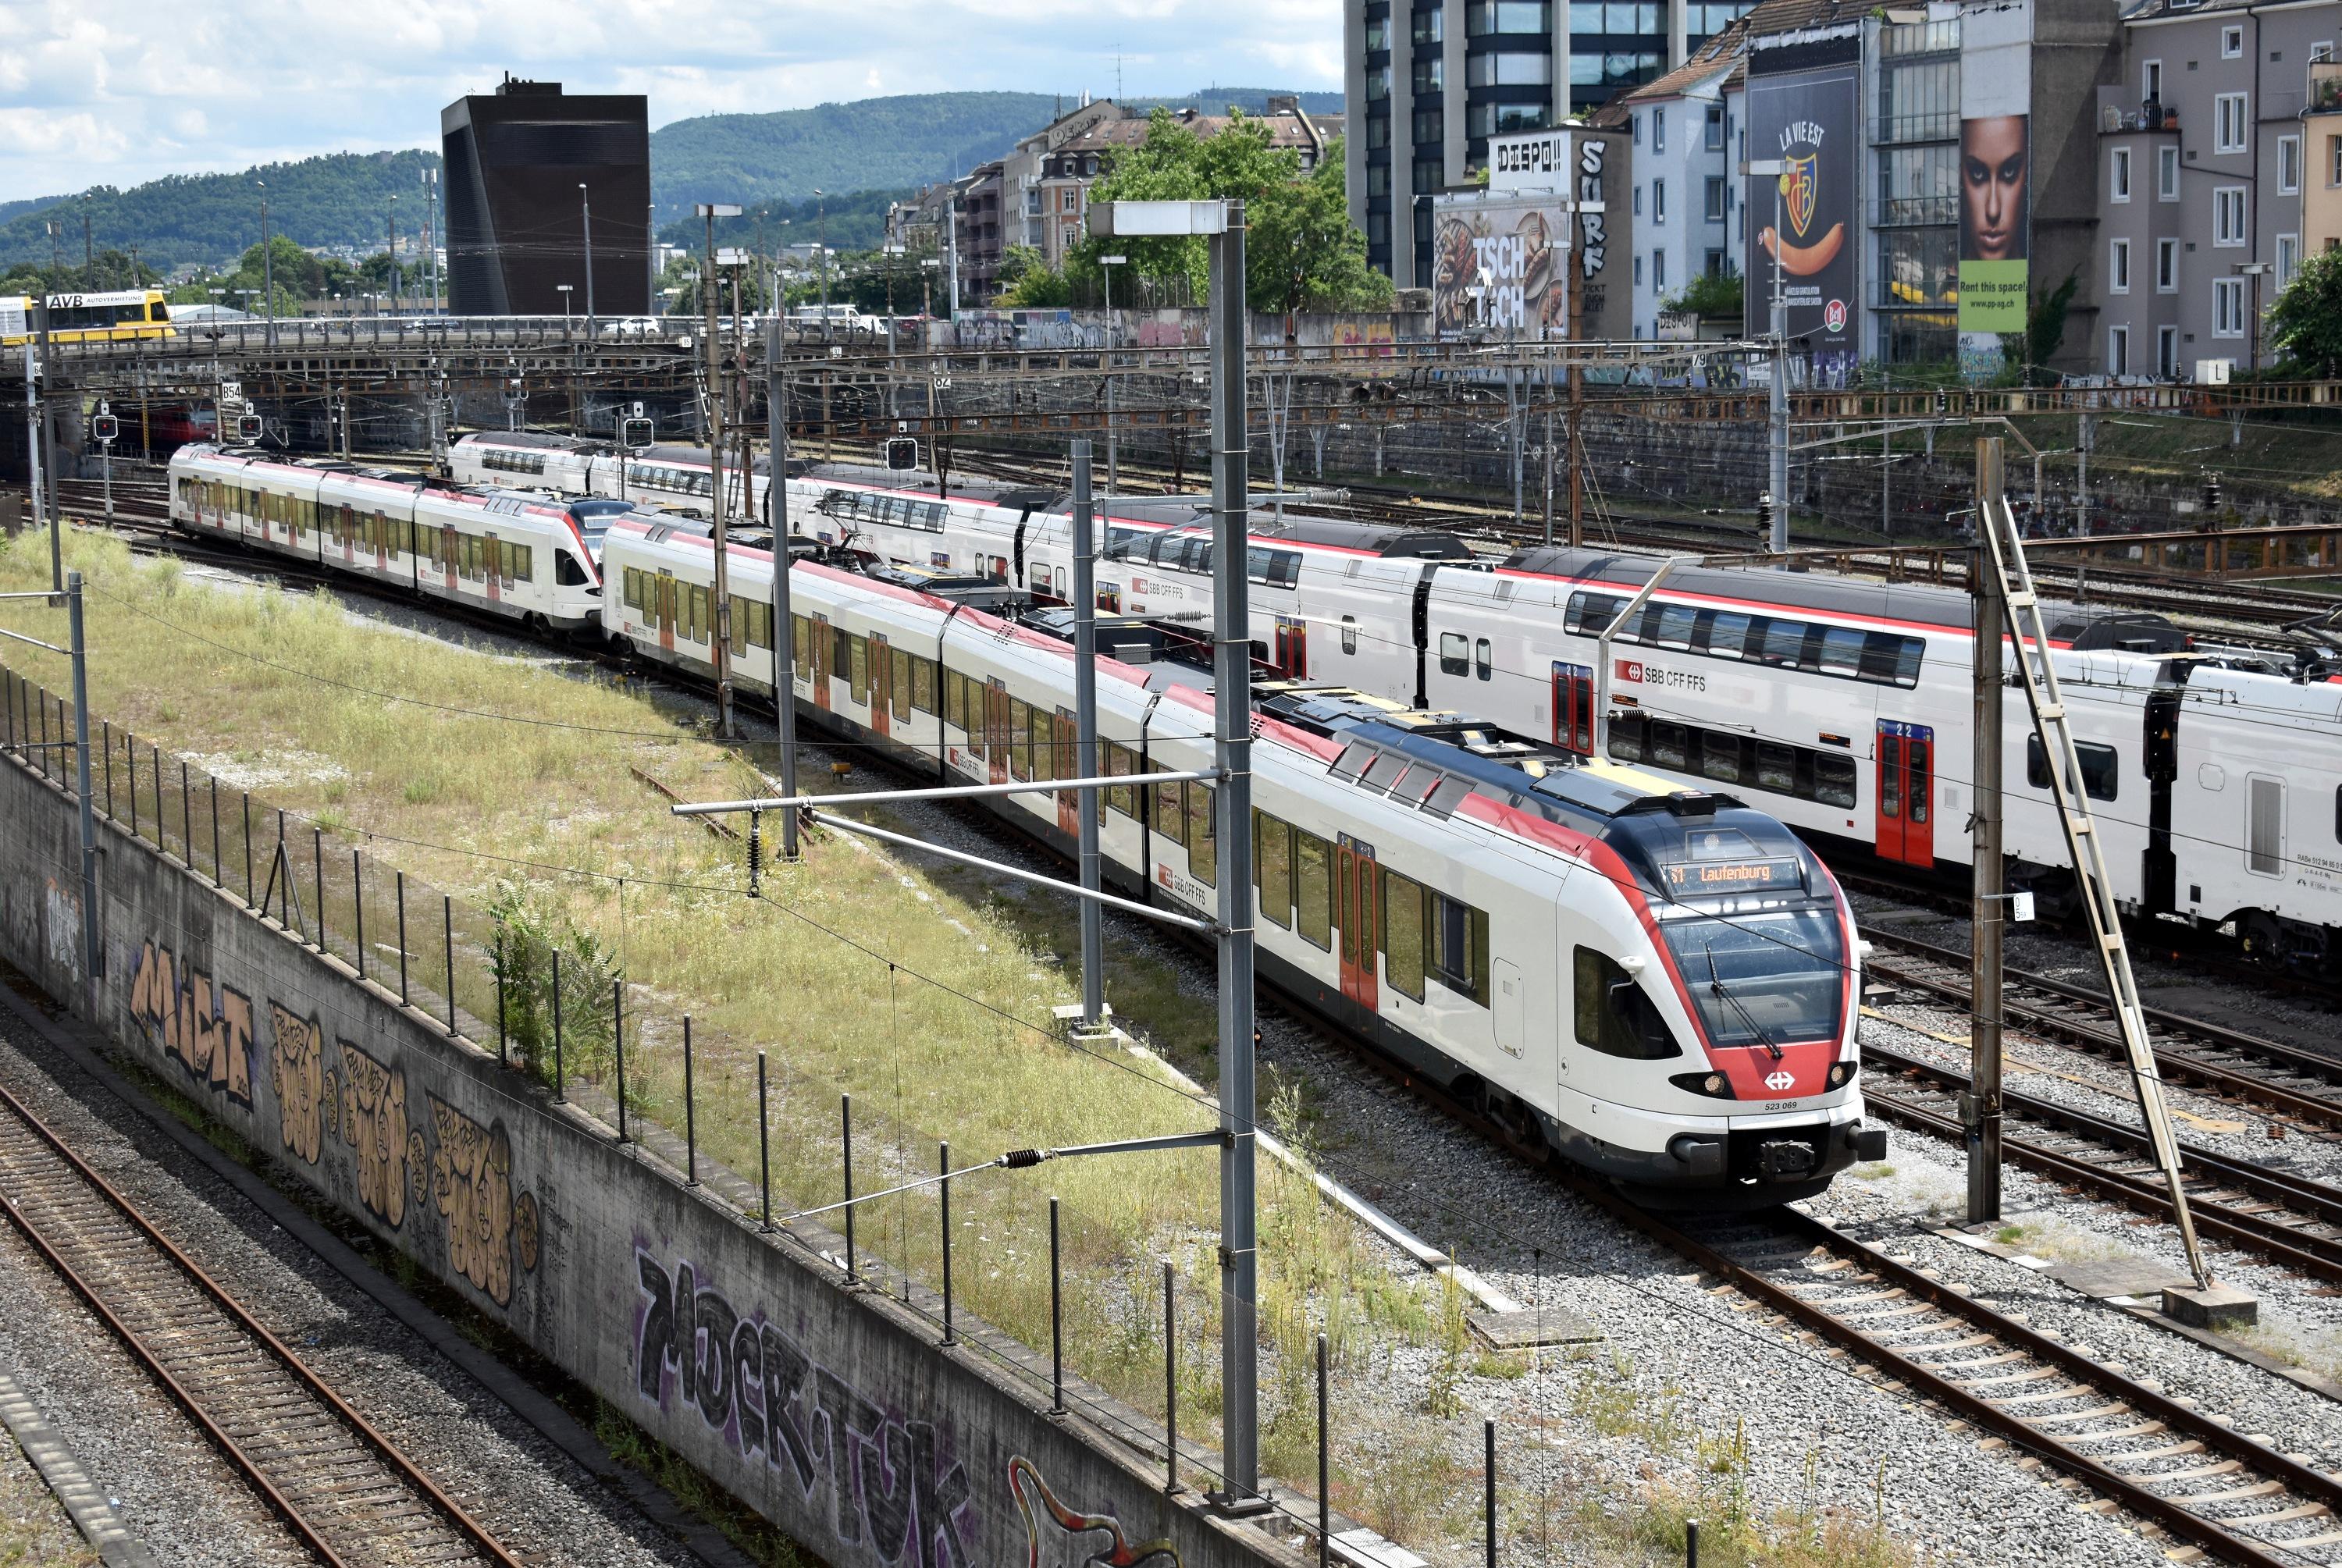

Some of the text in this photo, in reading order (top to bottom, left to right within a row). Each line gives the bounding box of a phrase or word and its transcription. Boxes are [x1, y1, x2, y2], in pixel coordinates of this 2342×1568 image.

[1779, 121, 1824, 151] LA VIE EST
[1473, 236, 1524, 279] TSCH
[1960, 282, 2026, 294] Rent this space!
[49, 295, 83, 308] AVB
[1970, 300, 2014, 309] www.pp-ag.ch
[1829, 306, 1842, 322] Bell
[2216, 364, 2222, 380] L
[223, 386, 240, 399] B54
[1149, 582, 1183, 599] SBB CFF FFS
[1566, 666, 1578, 676] 2 2
[1645, 667, 1705, 692] SBB CFF FFS
[1897, 724, 1911, 737] 2 2
[2312, 857, 2321, 866] 512
[1671, 866, 1771, 884] S1 Laufenburg
[1174, 875, 1184, 894] SBB
[1184, 881, 1194, 898] CFF
[1196, 887, 1205, 905] FFS
[2016, 897, 2020, 907] 0
[1782, 1101, 1797, 1110] 069
